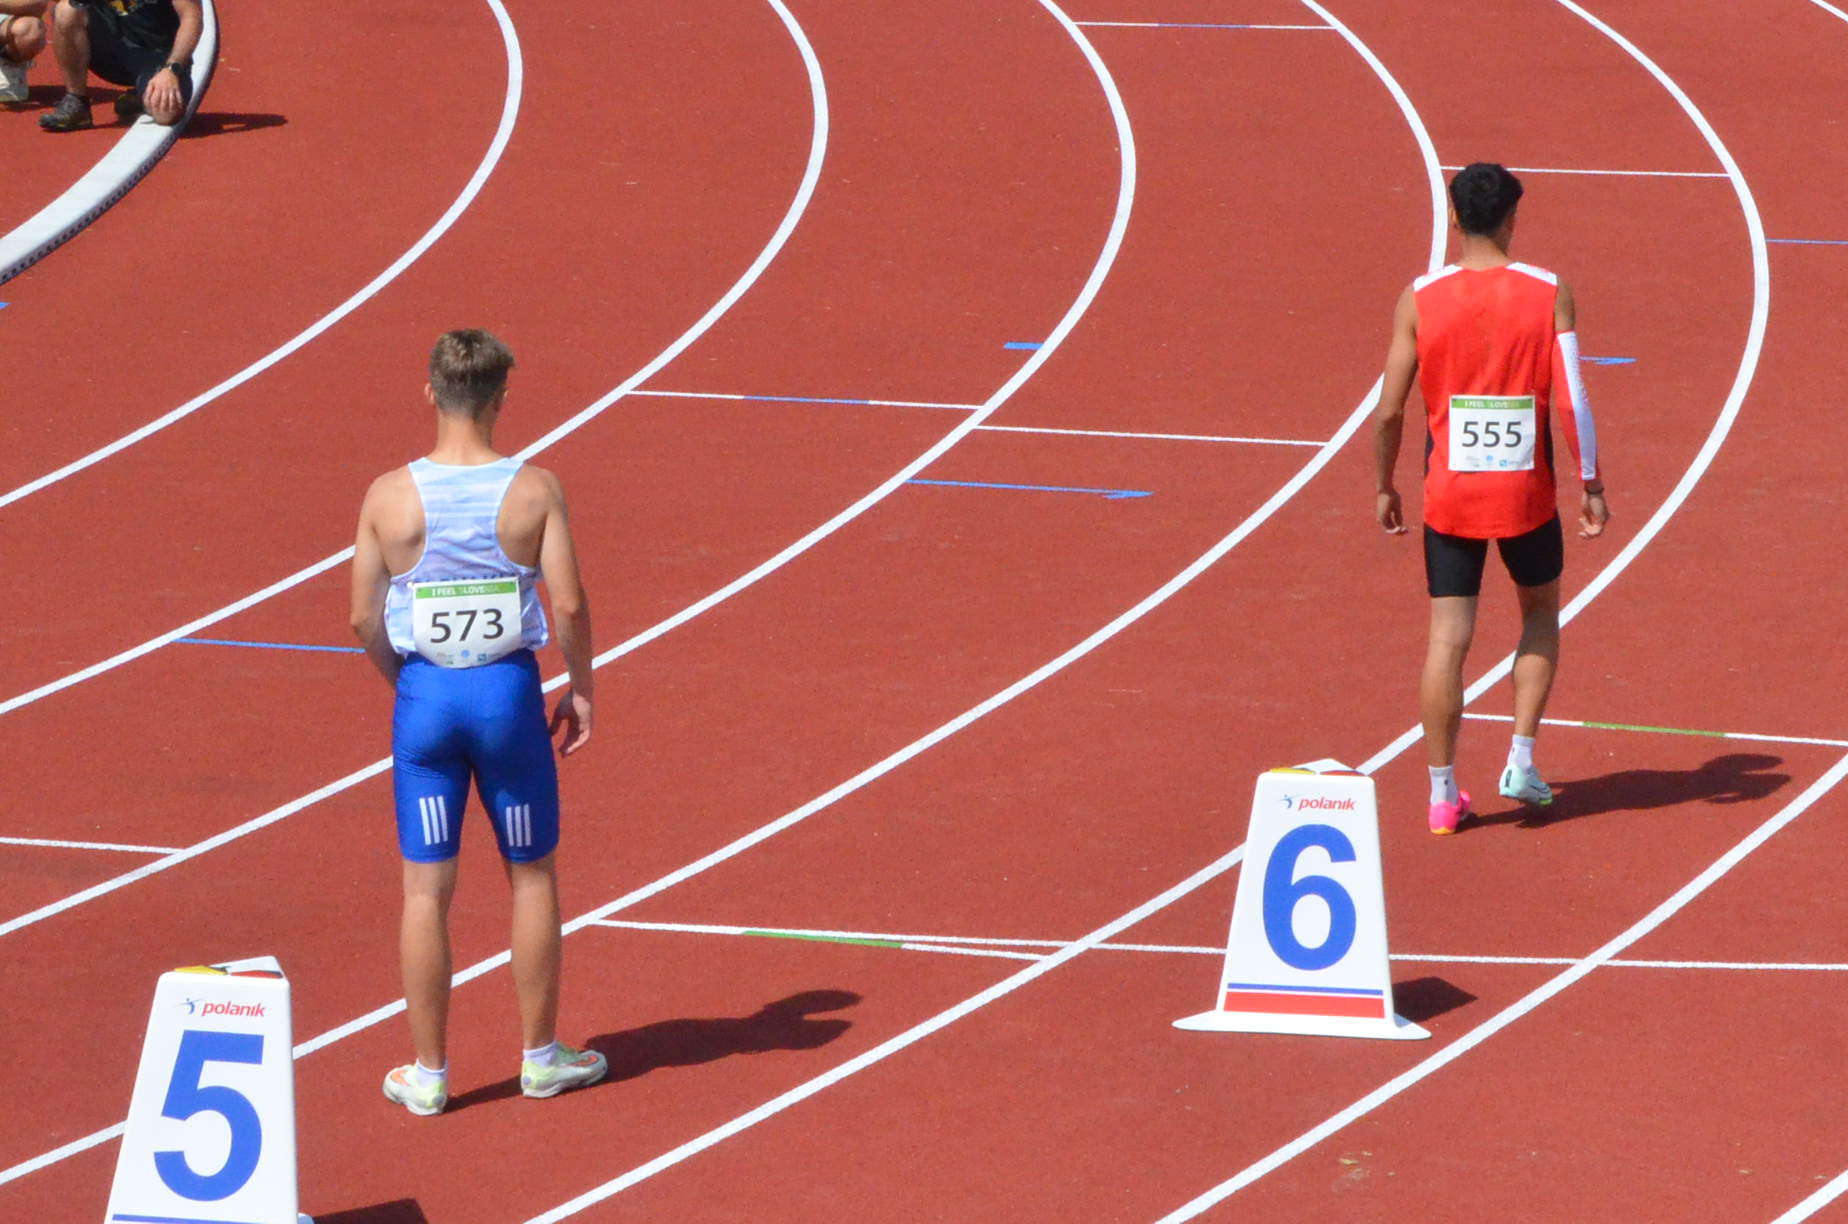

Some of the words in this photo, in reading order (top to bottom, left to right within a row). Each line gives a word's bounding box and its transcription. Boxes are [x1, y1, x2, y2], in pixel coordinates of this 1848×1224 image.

[1462, 421, 1522, 448] 555
[437, 586, 456, 596] FEEL
[430, 608, 504, 644] 573
[1298, 796, 1356, 811] polanik
[1262, 823, 1357, 971] 6
[201, 999, 267, 1017] polanik
[153, 1029, 265, 1202] 5
